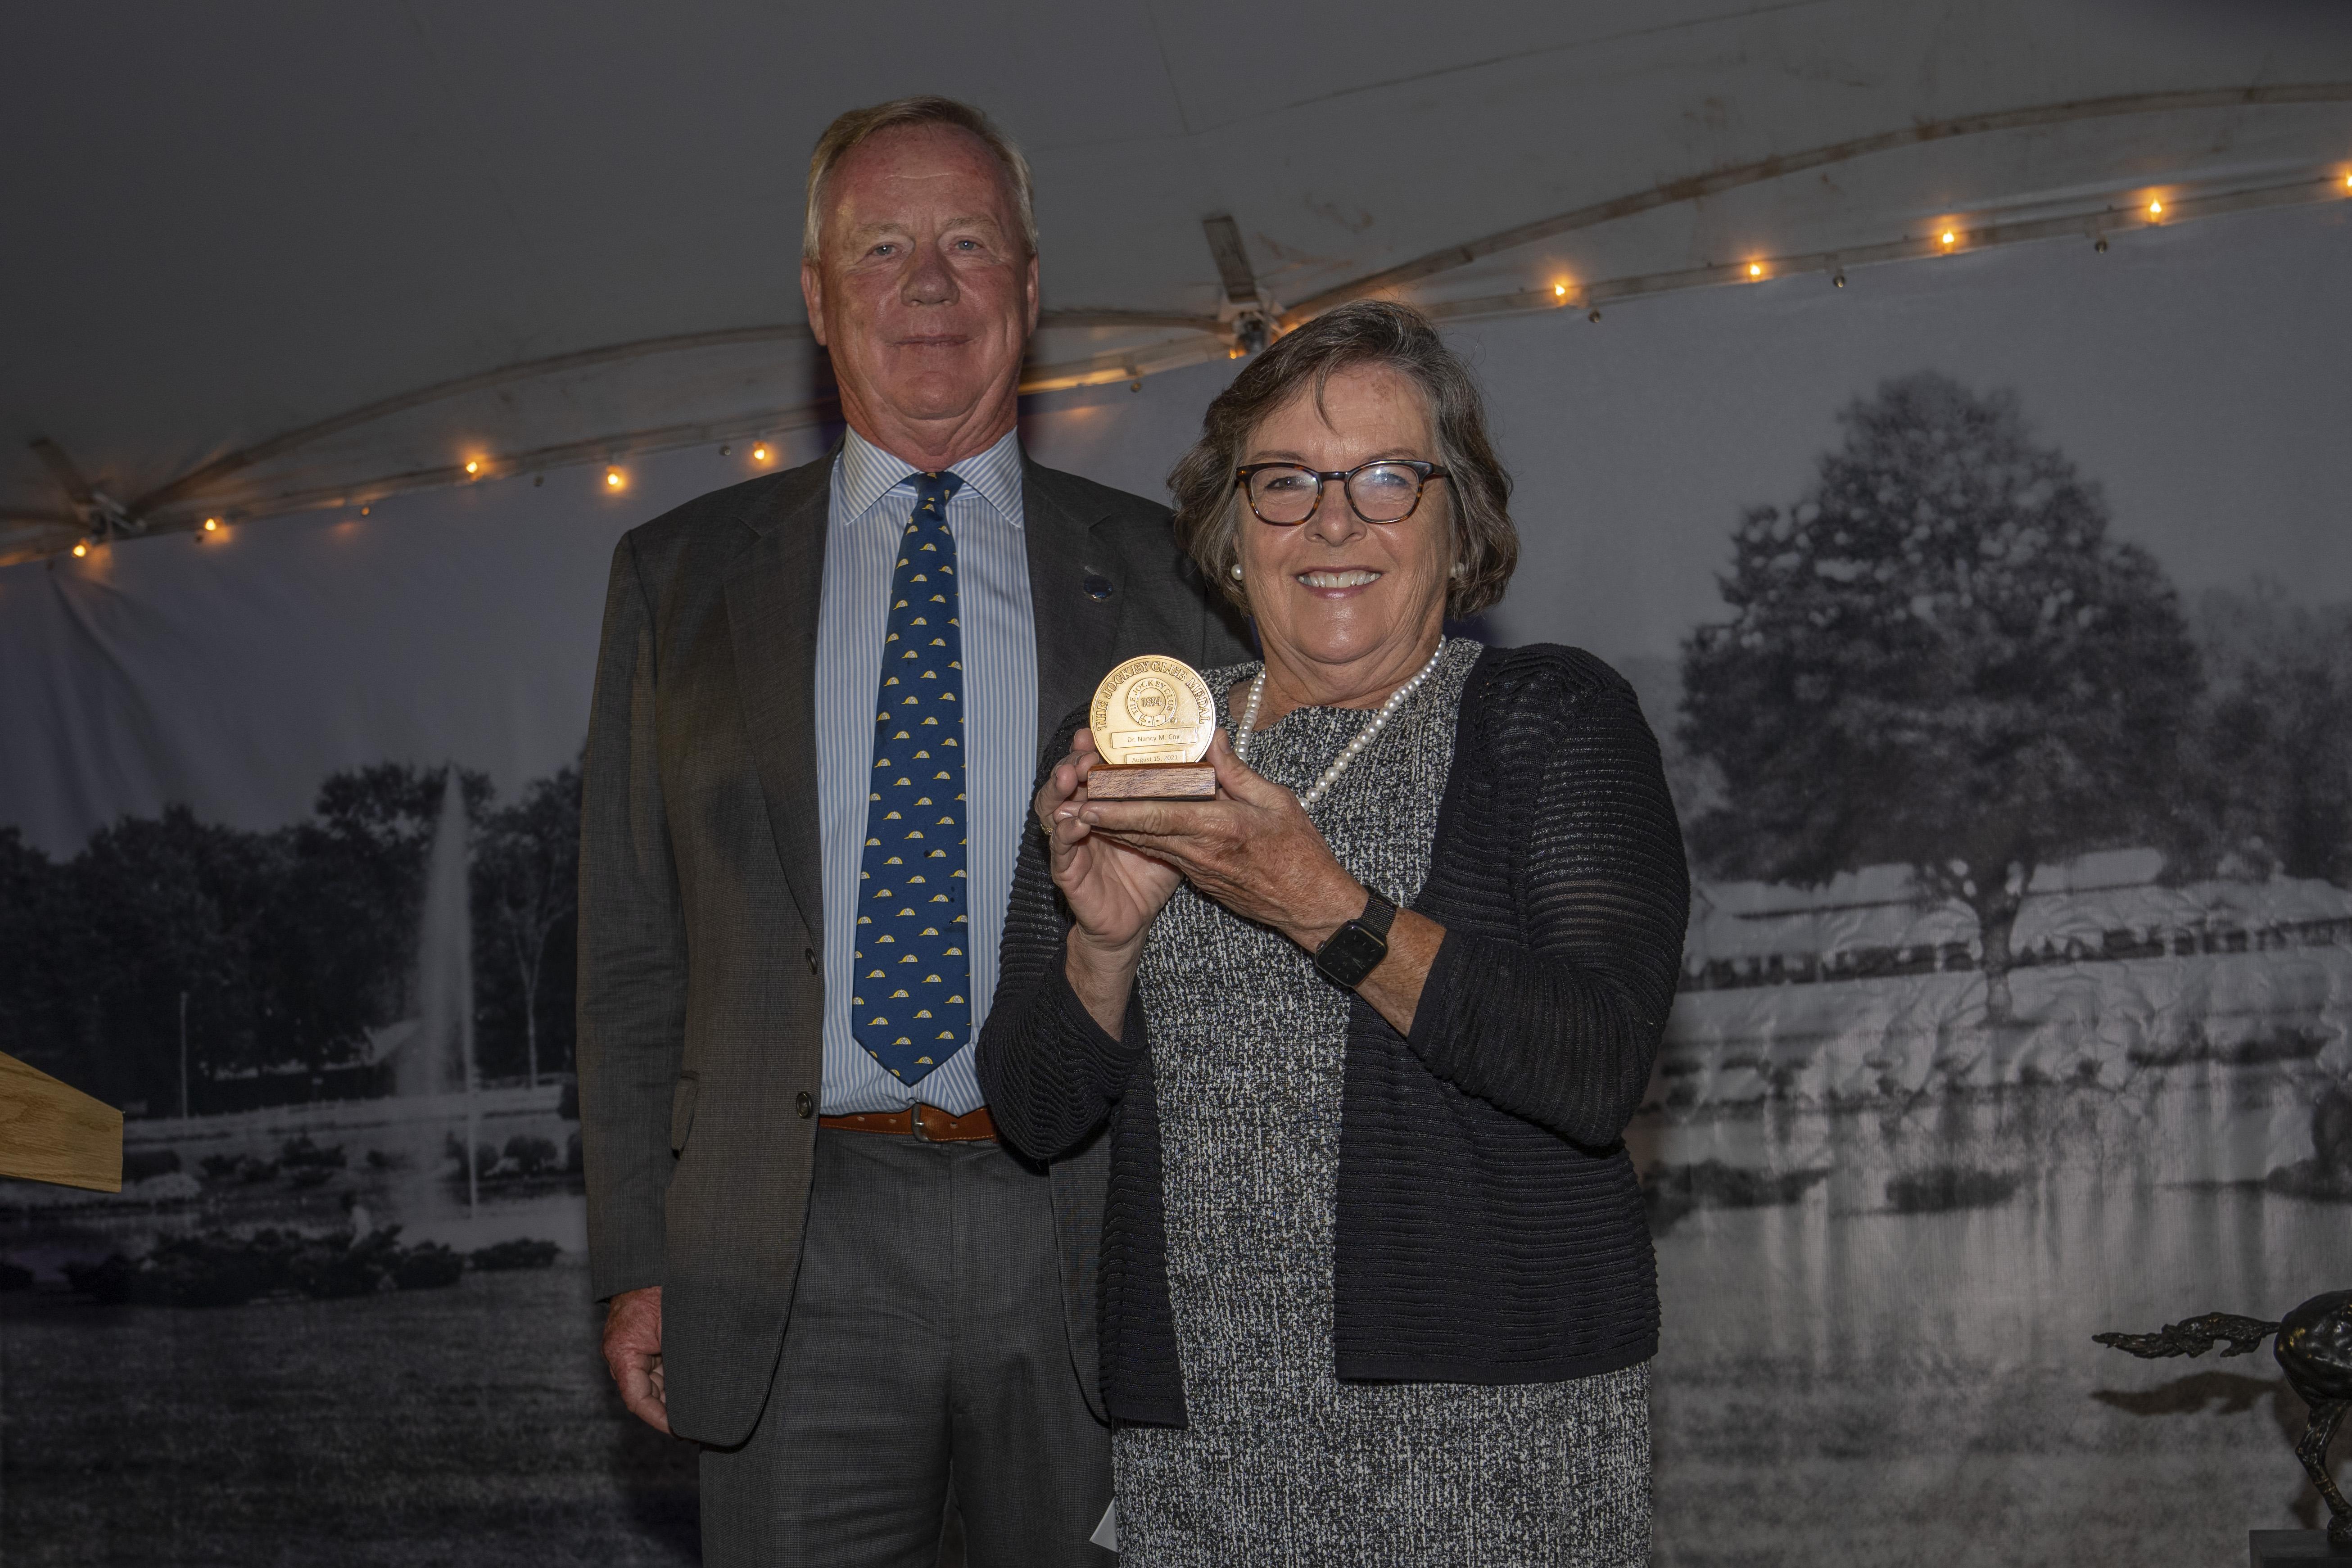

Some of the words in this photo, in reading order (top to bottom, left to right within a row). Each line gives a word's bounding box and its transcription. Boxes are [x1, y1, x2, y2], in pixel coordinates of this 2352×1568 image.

[1096, 700, 1108, 731] THE
[1103, 661, 1149, 699] JOCKEY
[1151, 661, 1187, 681] CLUB
[1185, 678, 1210, 724] MEDAL
[1133, 680, 1166, 696] JOCKEY
[1130, 697, 1138, 715] THE
[1141, 696, 1162, 707] 1894
[1164, 688, 1174, 711] CLUB
